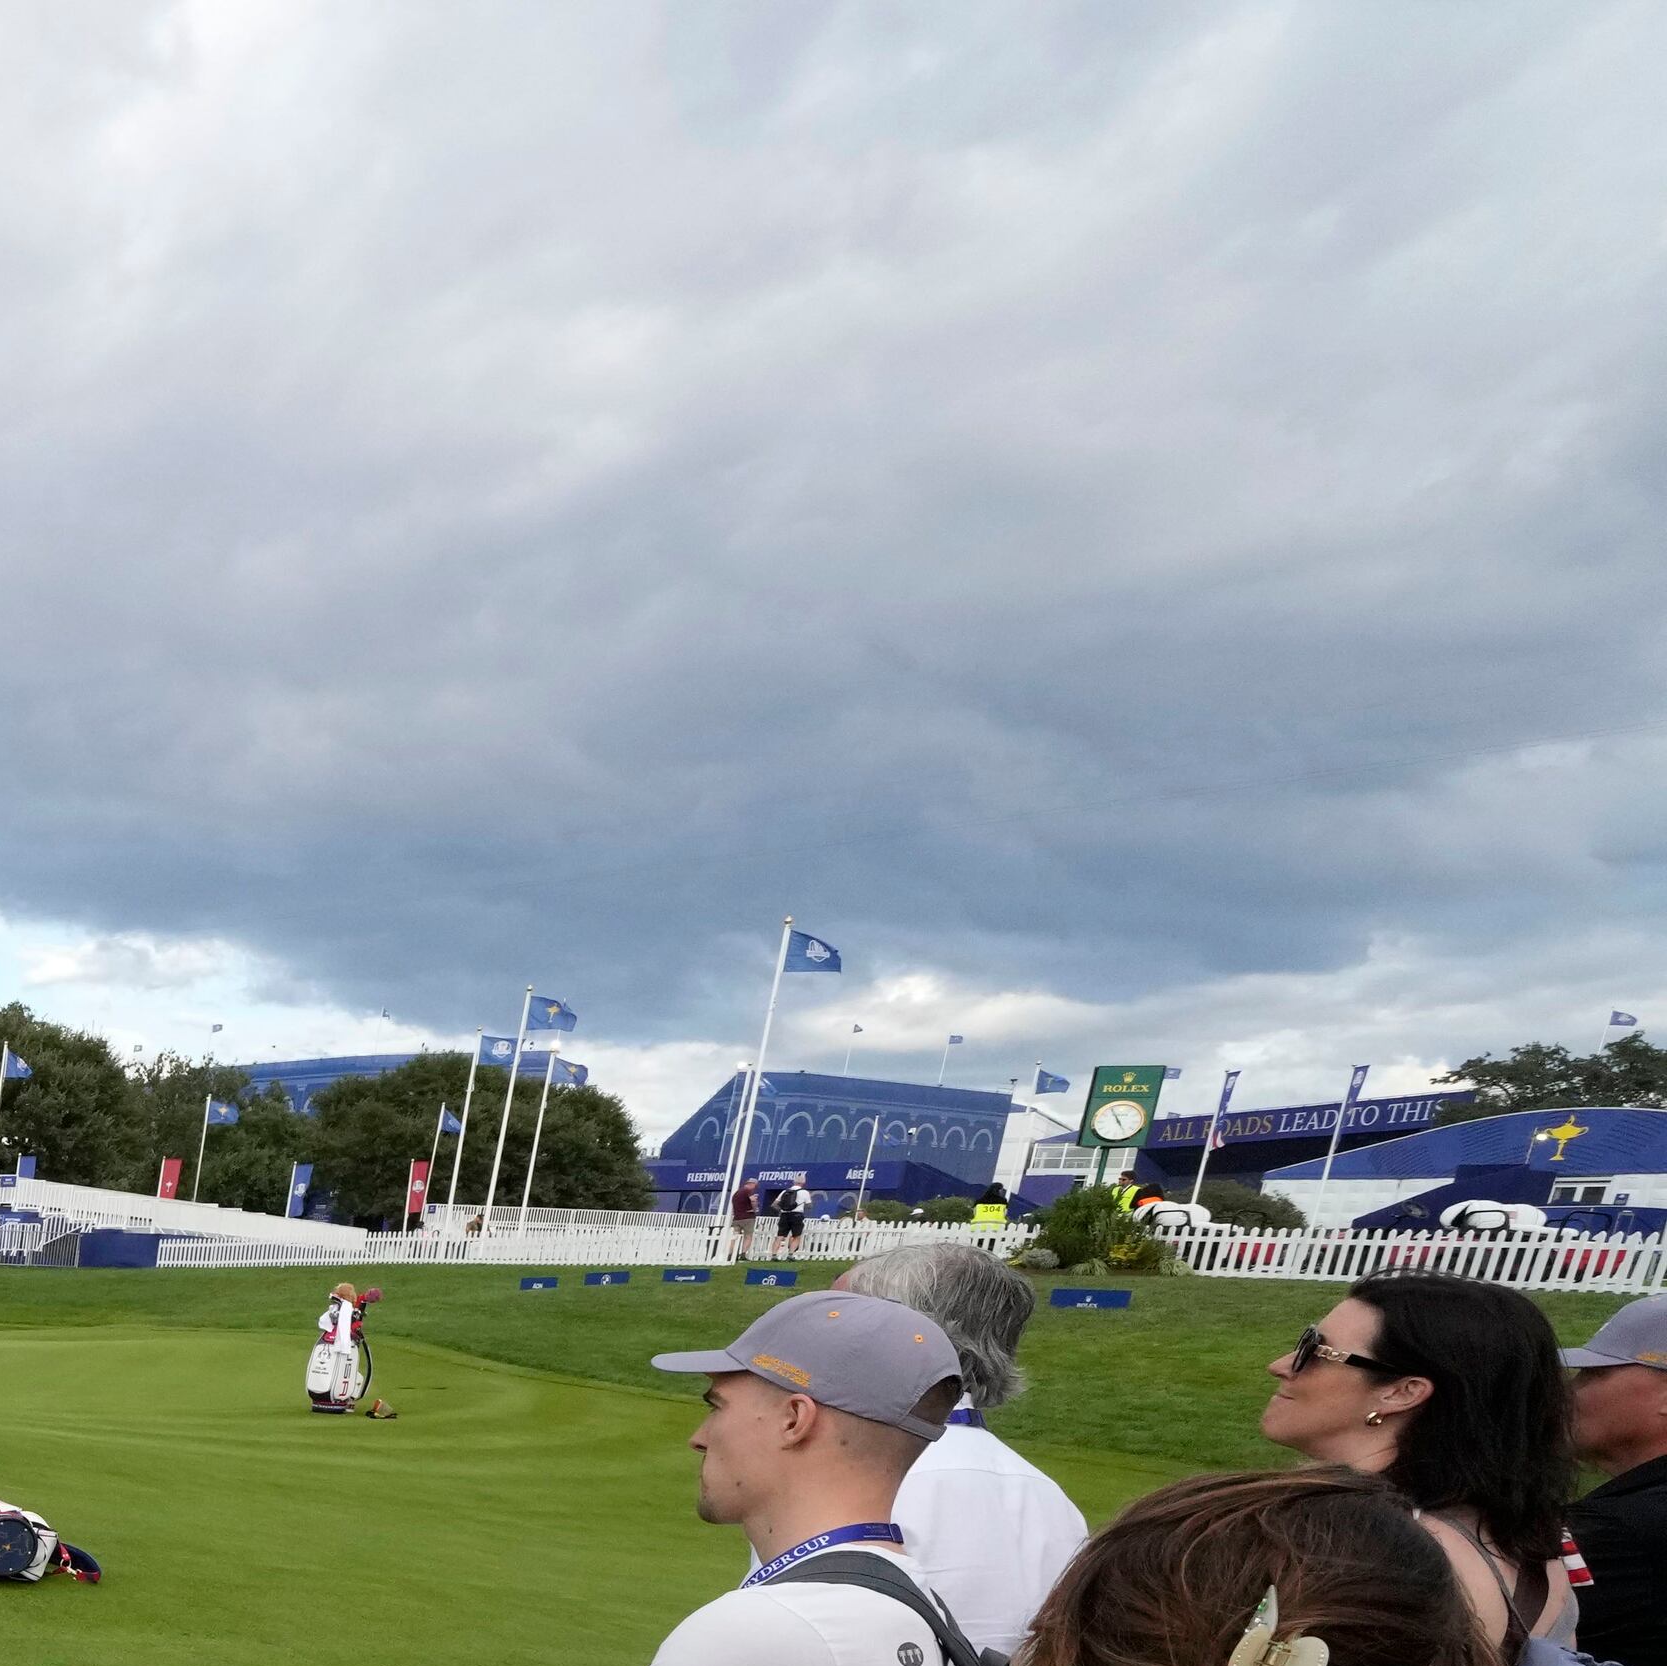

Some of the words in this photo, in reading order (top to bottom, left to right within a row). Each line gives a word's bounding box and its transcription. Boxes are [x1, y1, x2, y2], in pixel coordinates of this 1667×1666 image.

[1102, 1083, 1150, 1094] ROLEX
[1158, 1122, 1195, 1142] ALL
[1277, 1109, 1339, 1133] LEAD
[1347, 1105, 1380, 1128] TO
[686, 1172, 727, 1182] FLEETWOO
[982, 1205, 1002, 1213] 304
[761, 1275, 778, 1286] citi
[793, 1535, 830, 1557] CUP
